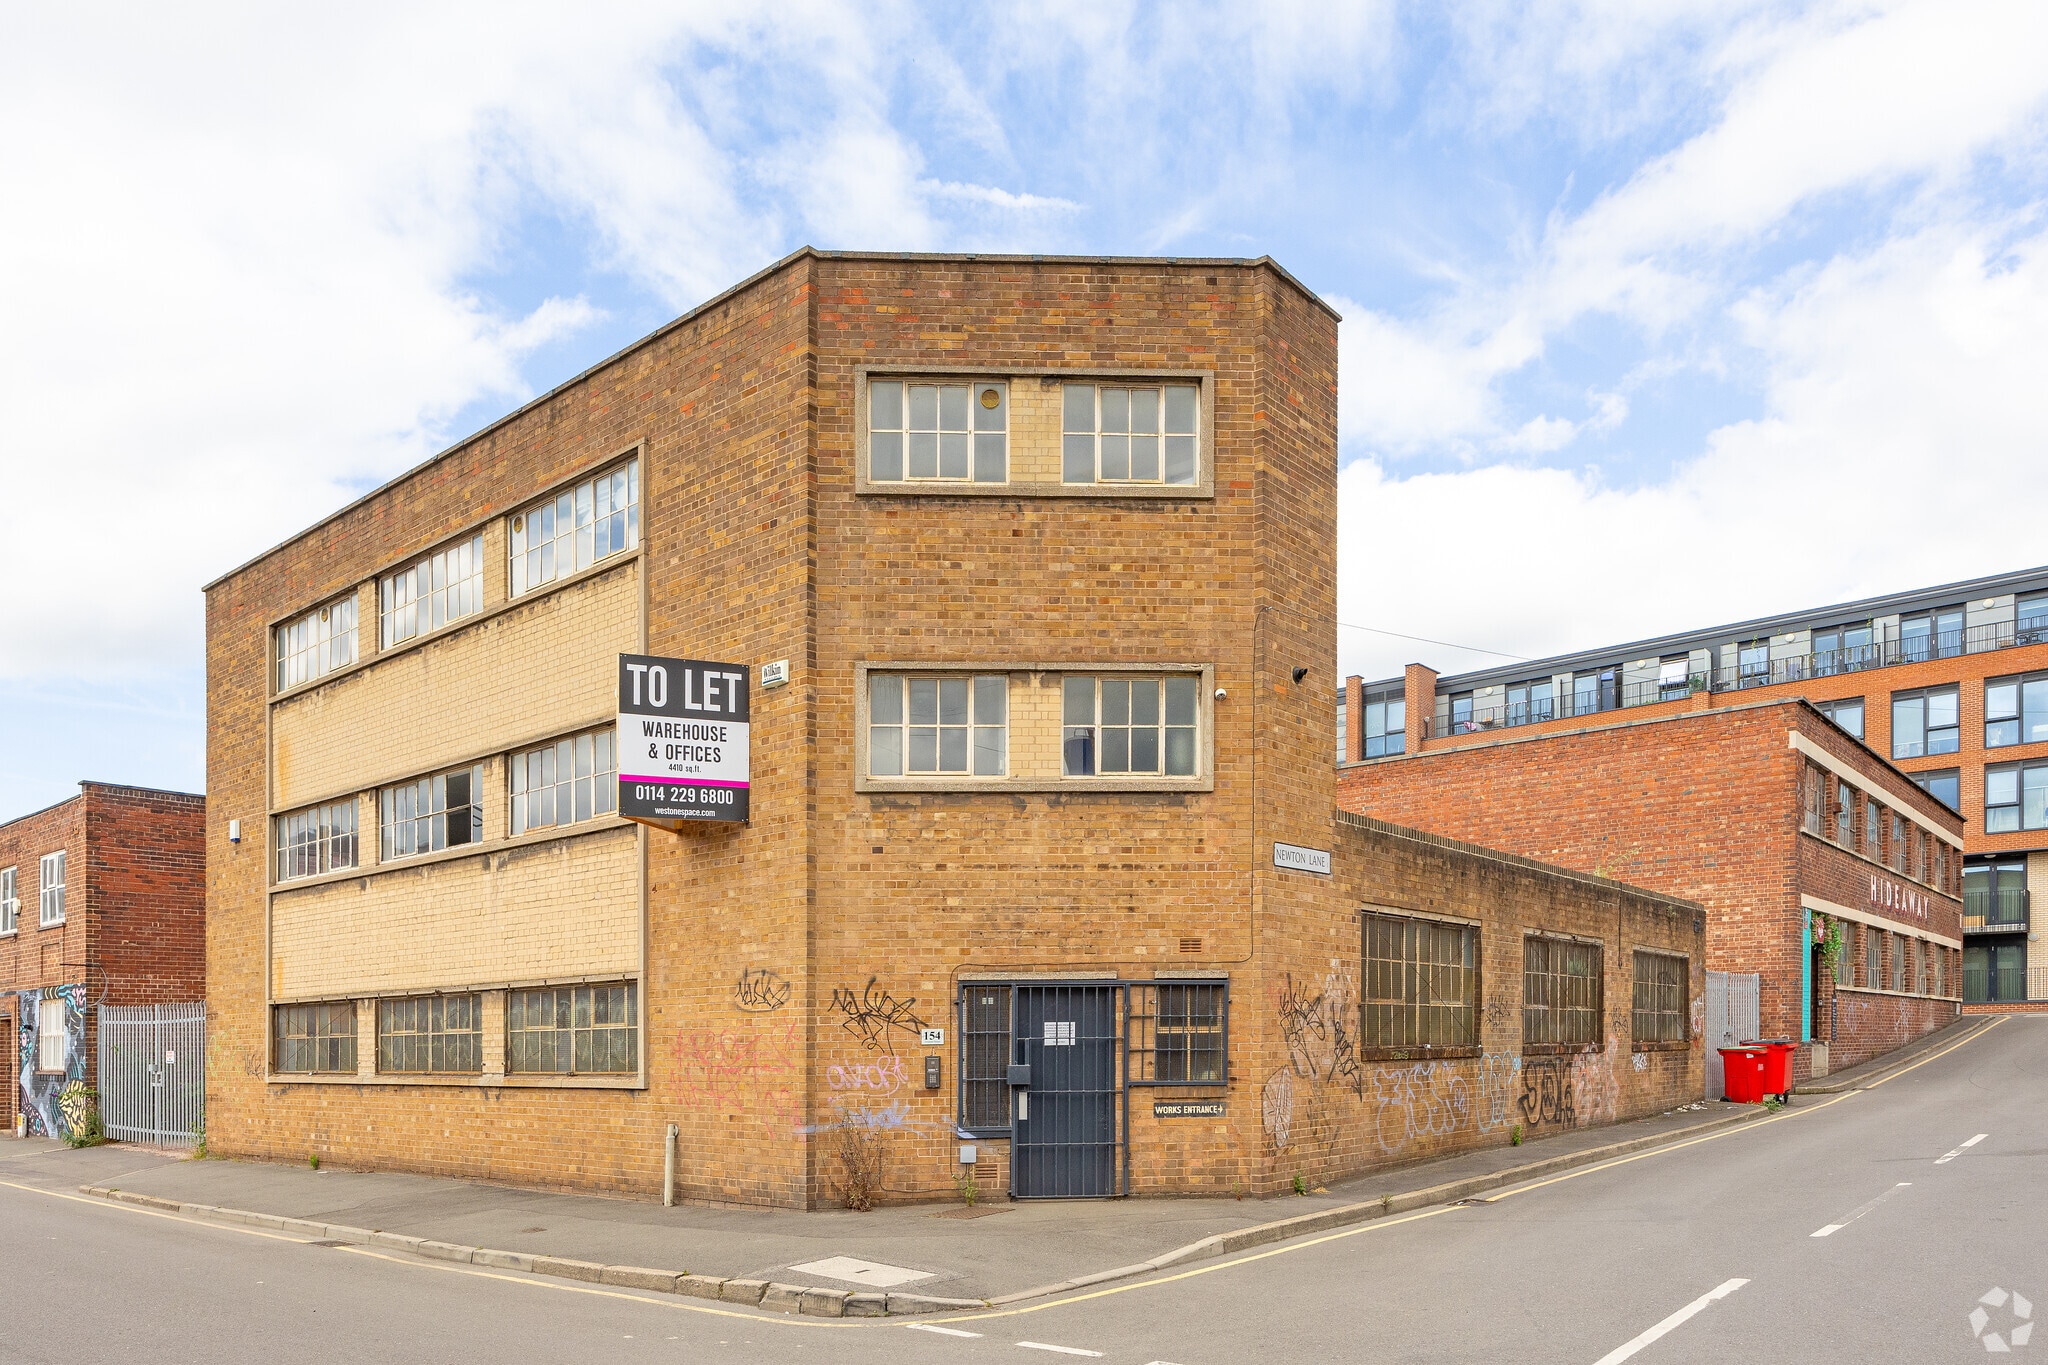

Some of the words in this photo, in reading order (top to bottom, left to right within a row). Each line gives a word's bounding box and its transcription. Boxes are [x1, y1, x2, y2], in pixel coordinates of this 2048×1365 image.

[626, 663, 668, 708] TO
[684, 668, 743, 714] LET
[642, 720, 728, 743] WAREHOUSE
[648, 742, 658, 759] &
[665, 743, 722, 763] OFFICES
[668, 763, 683, 772] 4410
[685, 764, 702, 774] sq.ft.
[635, 785, 665, 802] 0114
[670, 787, 696, 803] 229
[700, 788, 734, 805] 6800
[654, 806, 716, 818] westonespace.com
[1276, 848, 1306, 864] NEWTON
[1309, 854, 1325, 868] LANE
[1870, 874, 1929, 920] HIDEAWAY
[924, 1031, 941, 1041] 154
[1155, 1105, 1182, 1114] WORKS
[1183, 1104, 1218, 1114] ENTRANCE
